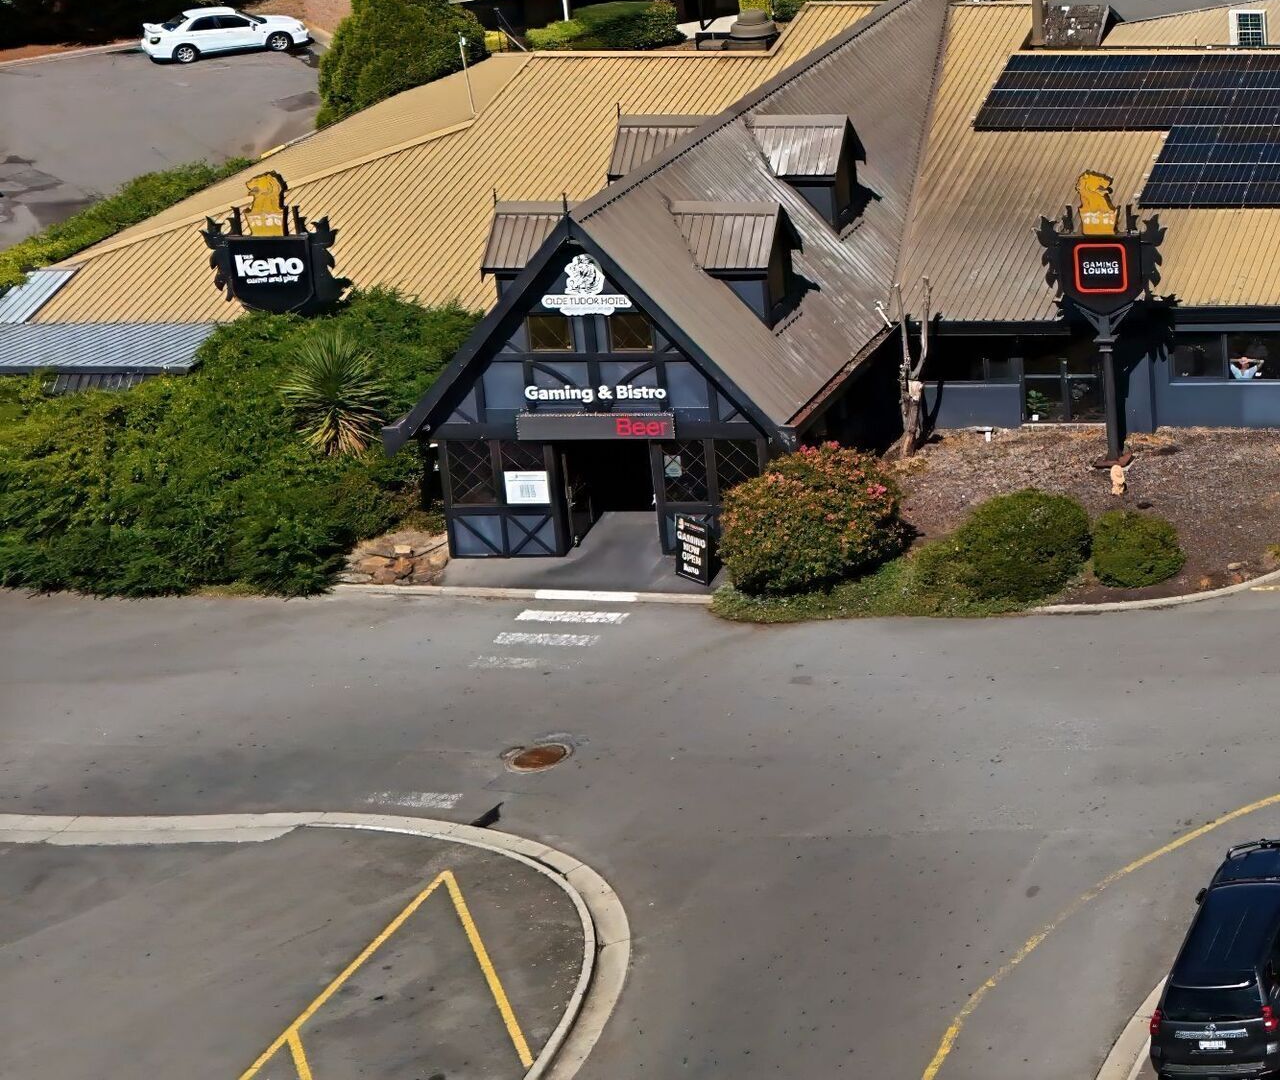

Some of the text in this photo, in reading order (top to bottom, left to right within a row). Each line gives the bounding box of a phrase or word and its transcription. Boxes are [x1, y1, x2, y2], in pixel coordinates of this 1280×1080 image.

[234, 254, 305, 277] keno
[1083, 267, 1119, 275] LOUNGE
[524, 384, 667, 403] Gaming & Bistro
[615, 417, 668, 436] Beer
[681, 551, 702, 567] OPEN
